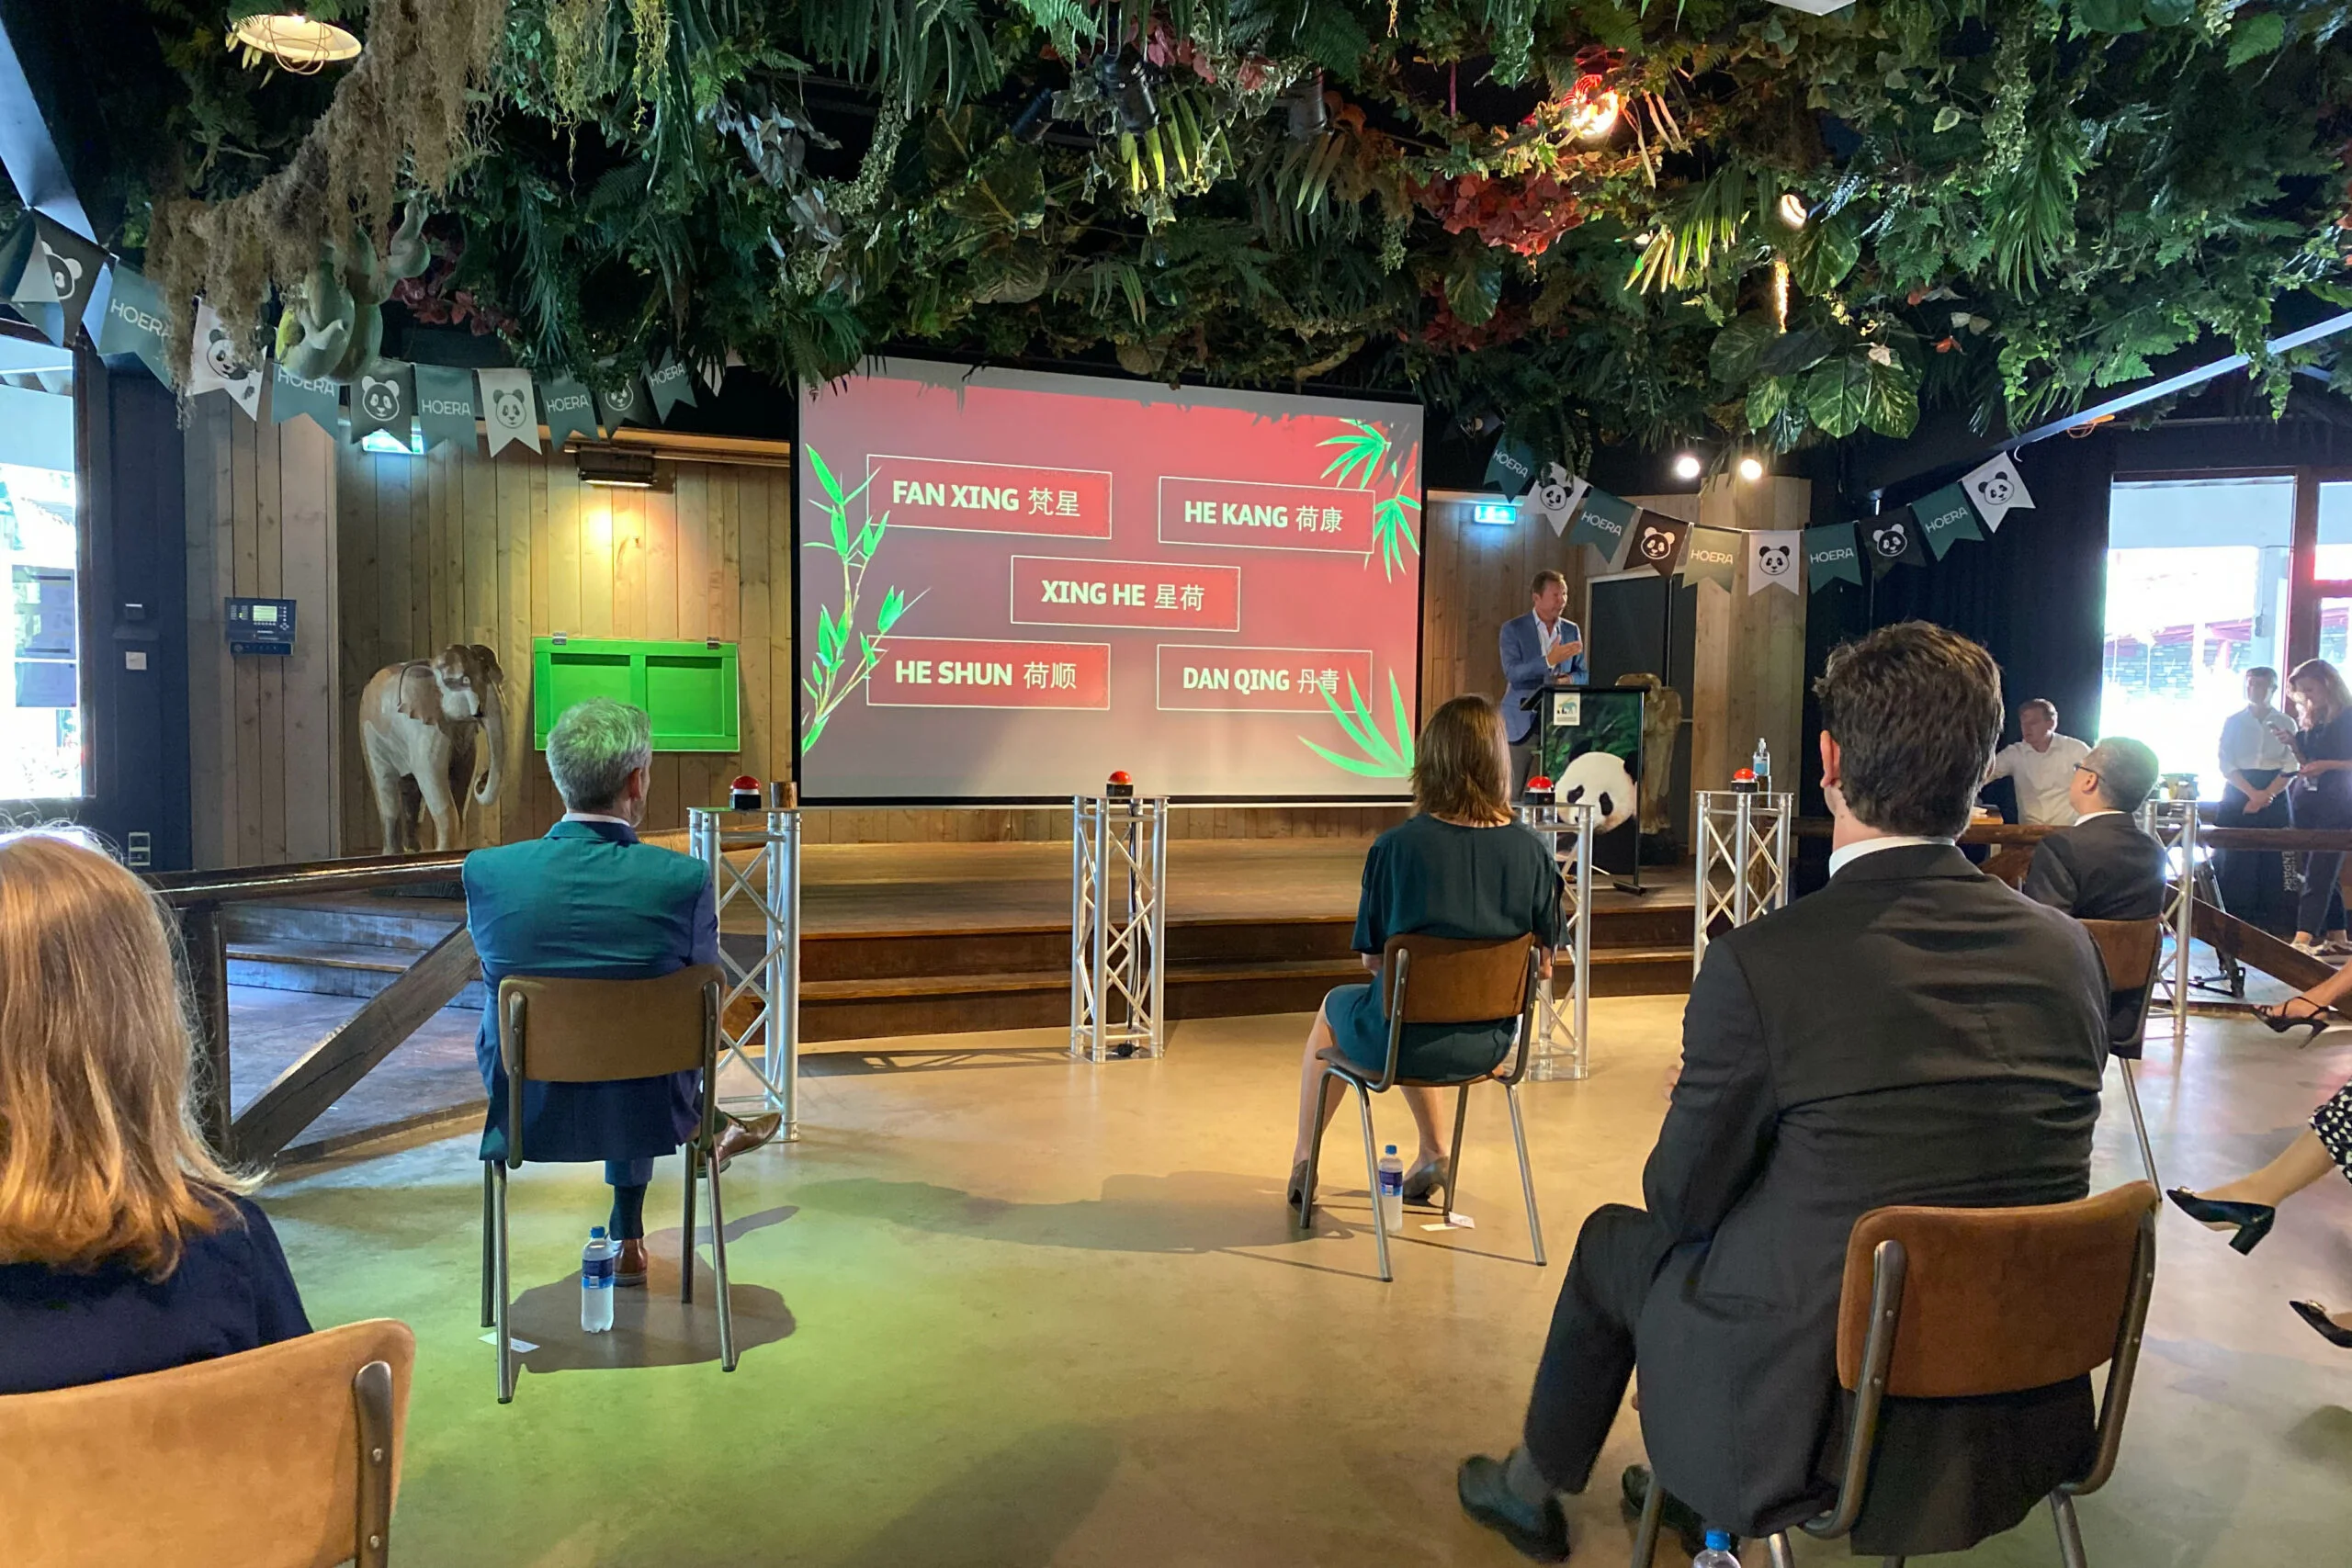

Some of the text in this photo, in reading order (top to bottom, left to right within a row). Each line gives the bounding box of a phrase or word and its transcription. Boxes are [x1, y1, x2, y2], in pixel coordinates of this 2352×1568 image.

[649, 363, 685, 387] HOERA
[421, 399, 471, 416] HOERA
[546, 394, 590, 413] HOERA
[1492, 449, 1529, 479] HOERA
[892, 479, 1081, 517] FAN XING 梵星
[1184, 500, 1343, 534] HE KANG 荷康
[1581, 511, 1623, 537] HOERA
[1925, 506, 1969, 534] HOERA
[1690, 548, 1734, 565] HOERA
[1809, 547, 1854, 565] HOERA
[1041, 579, 1204, 611] XING HE 星荷
[895, 660, 1077, 689] HE SHUN 荷顺
[1182, 667, 1340, 695] DAN QING 丹青
